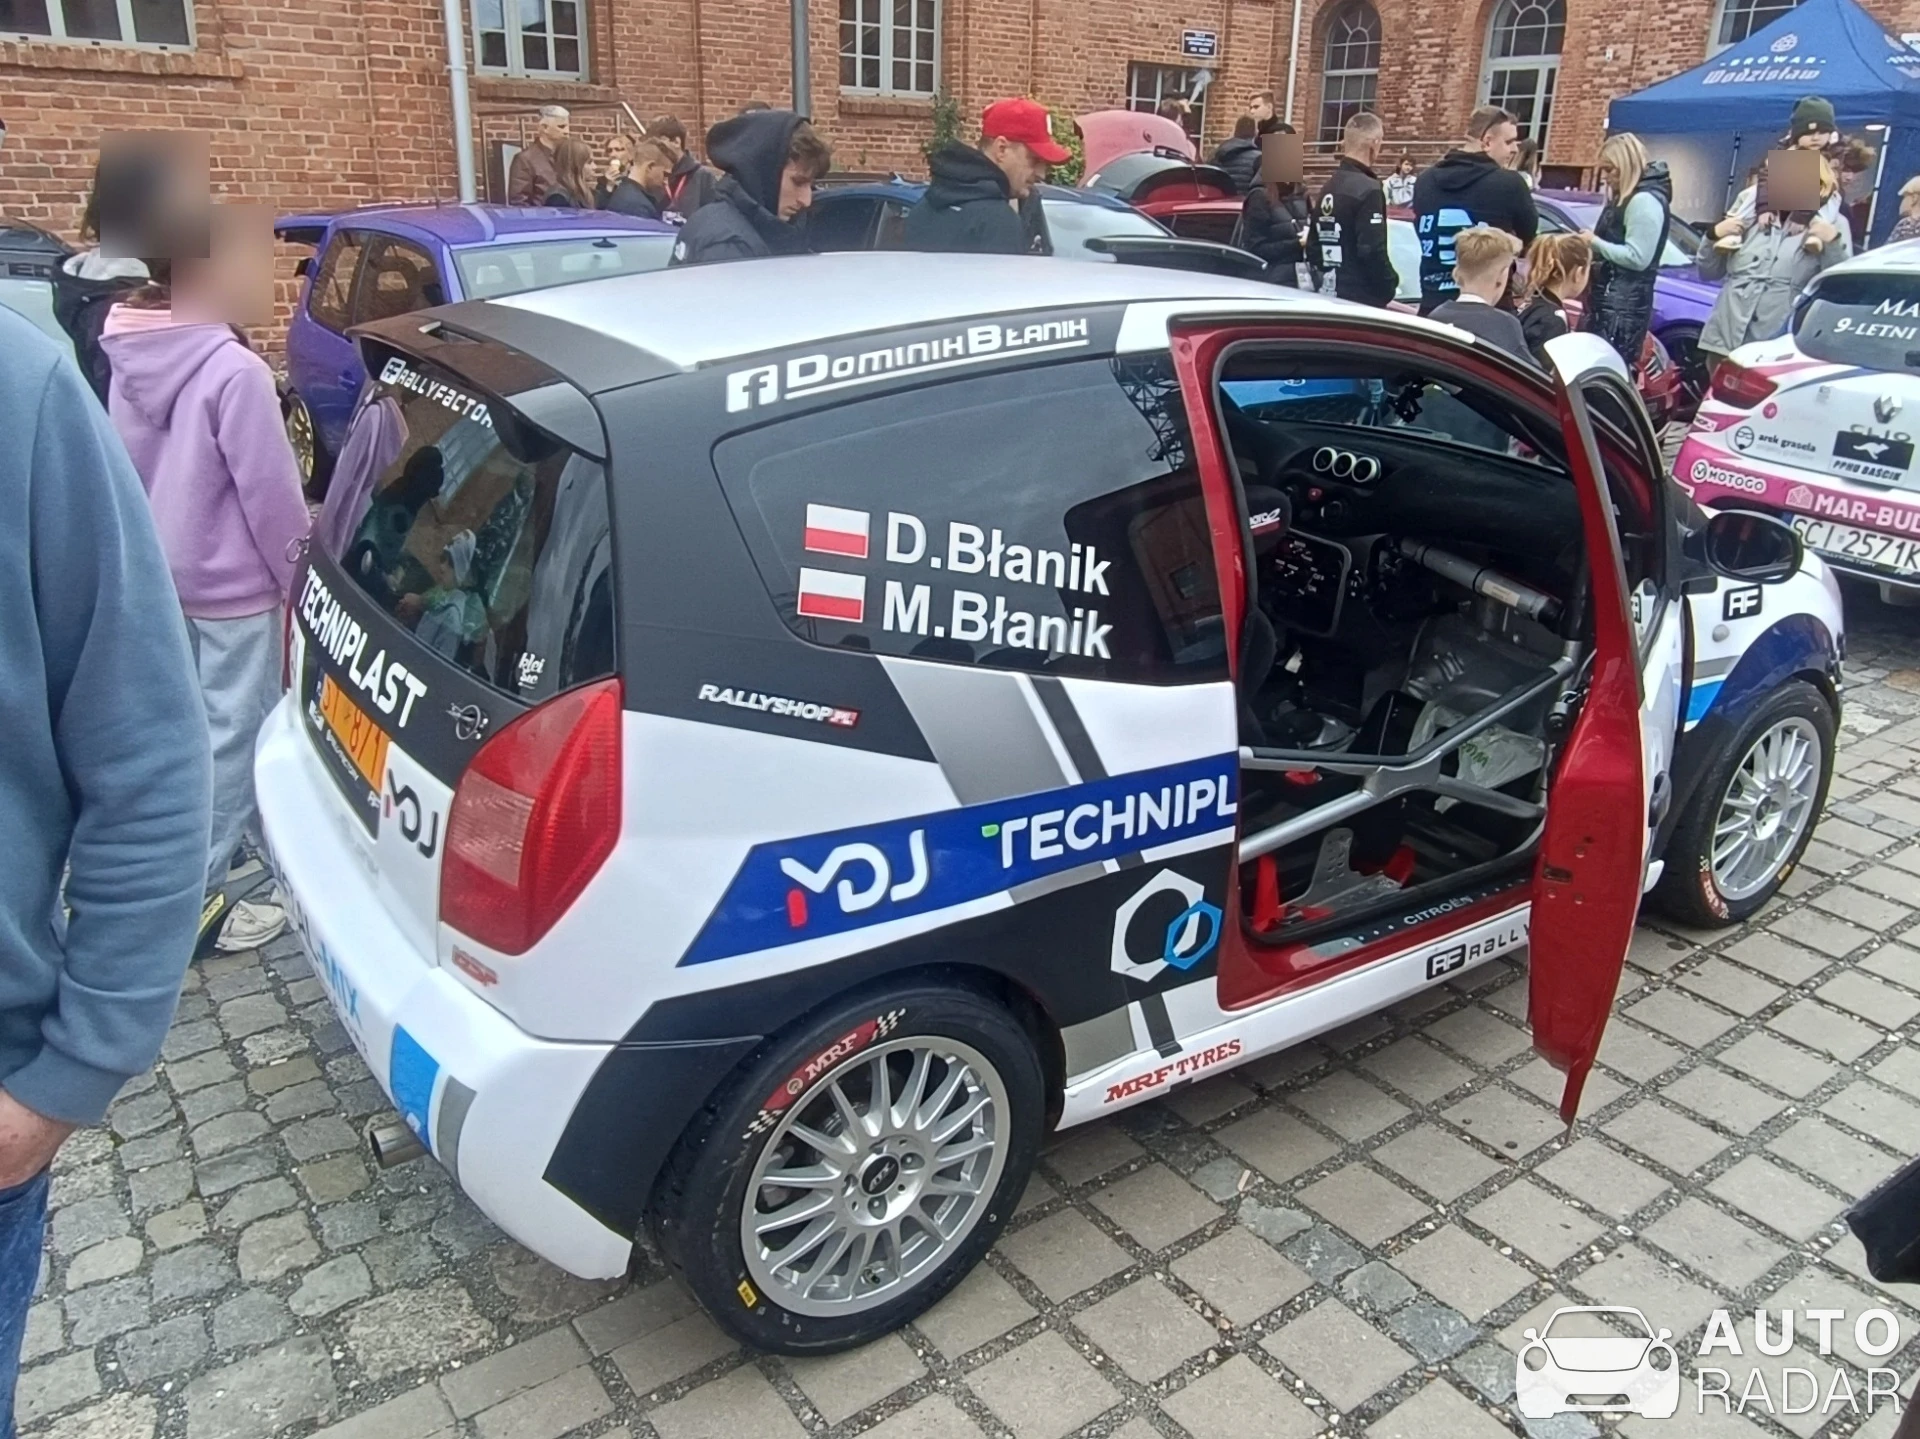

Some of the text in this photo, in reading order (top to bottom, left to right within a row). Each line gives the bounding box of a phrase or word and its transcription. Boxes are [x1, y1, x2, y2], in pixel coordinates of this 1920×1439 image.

[1833, 317, 1918, 340] 9-LETNI
[1708, 469, 1764, 492] MOTOGO
[886, 512, 1111, 596] D.Błanik
[299, 564, 428, 728] TECHNIPLAST
[882, 581, 1113, 660] M.Błanik
[1403, 895, 1474, 925] CITROËN
[805, 1033, 857, 1081] MRF
[1103, 1038, 1241, 1104] MRF TYRES
